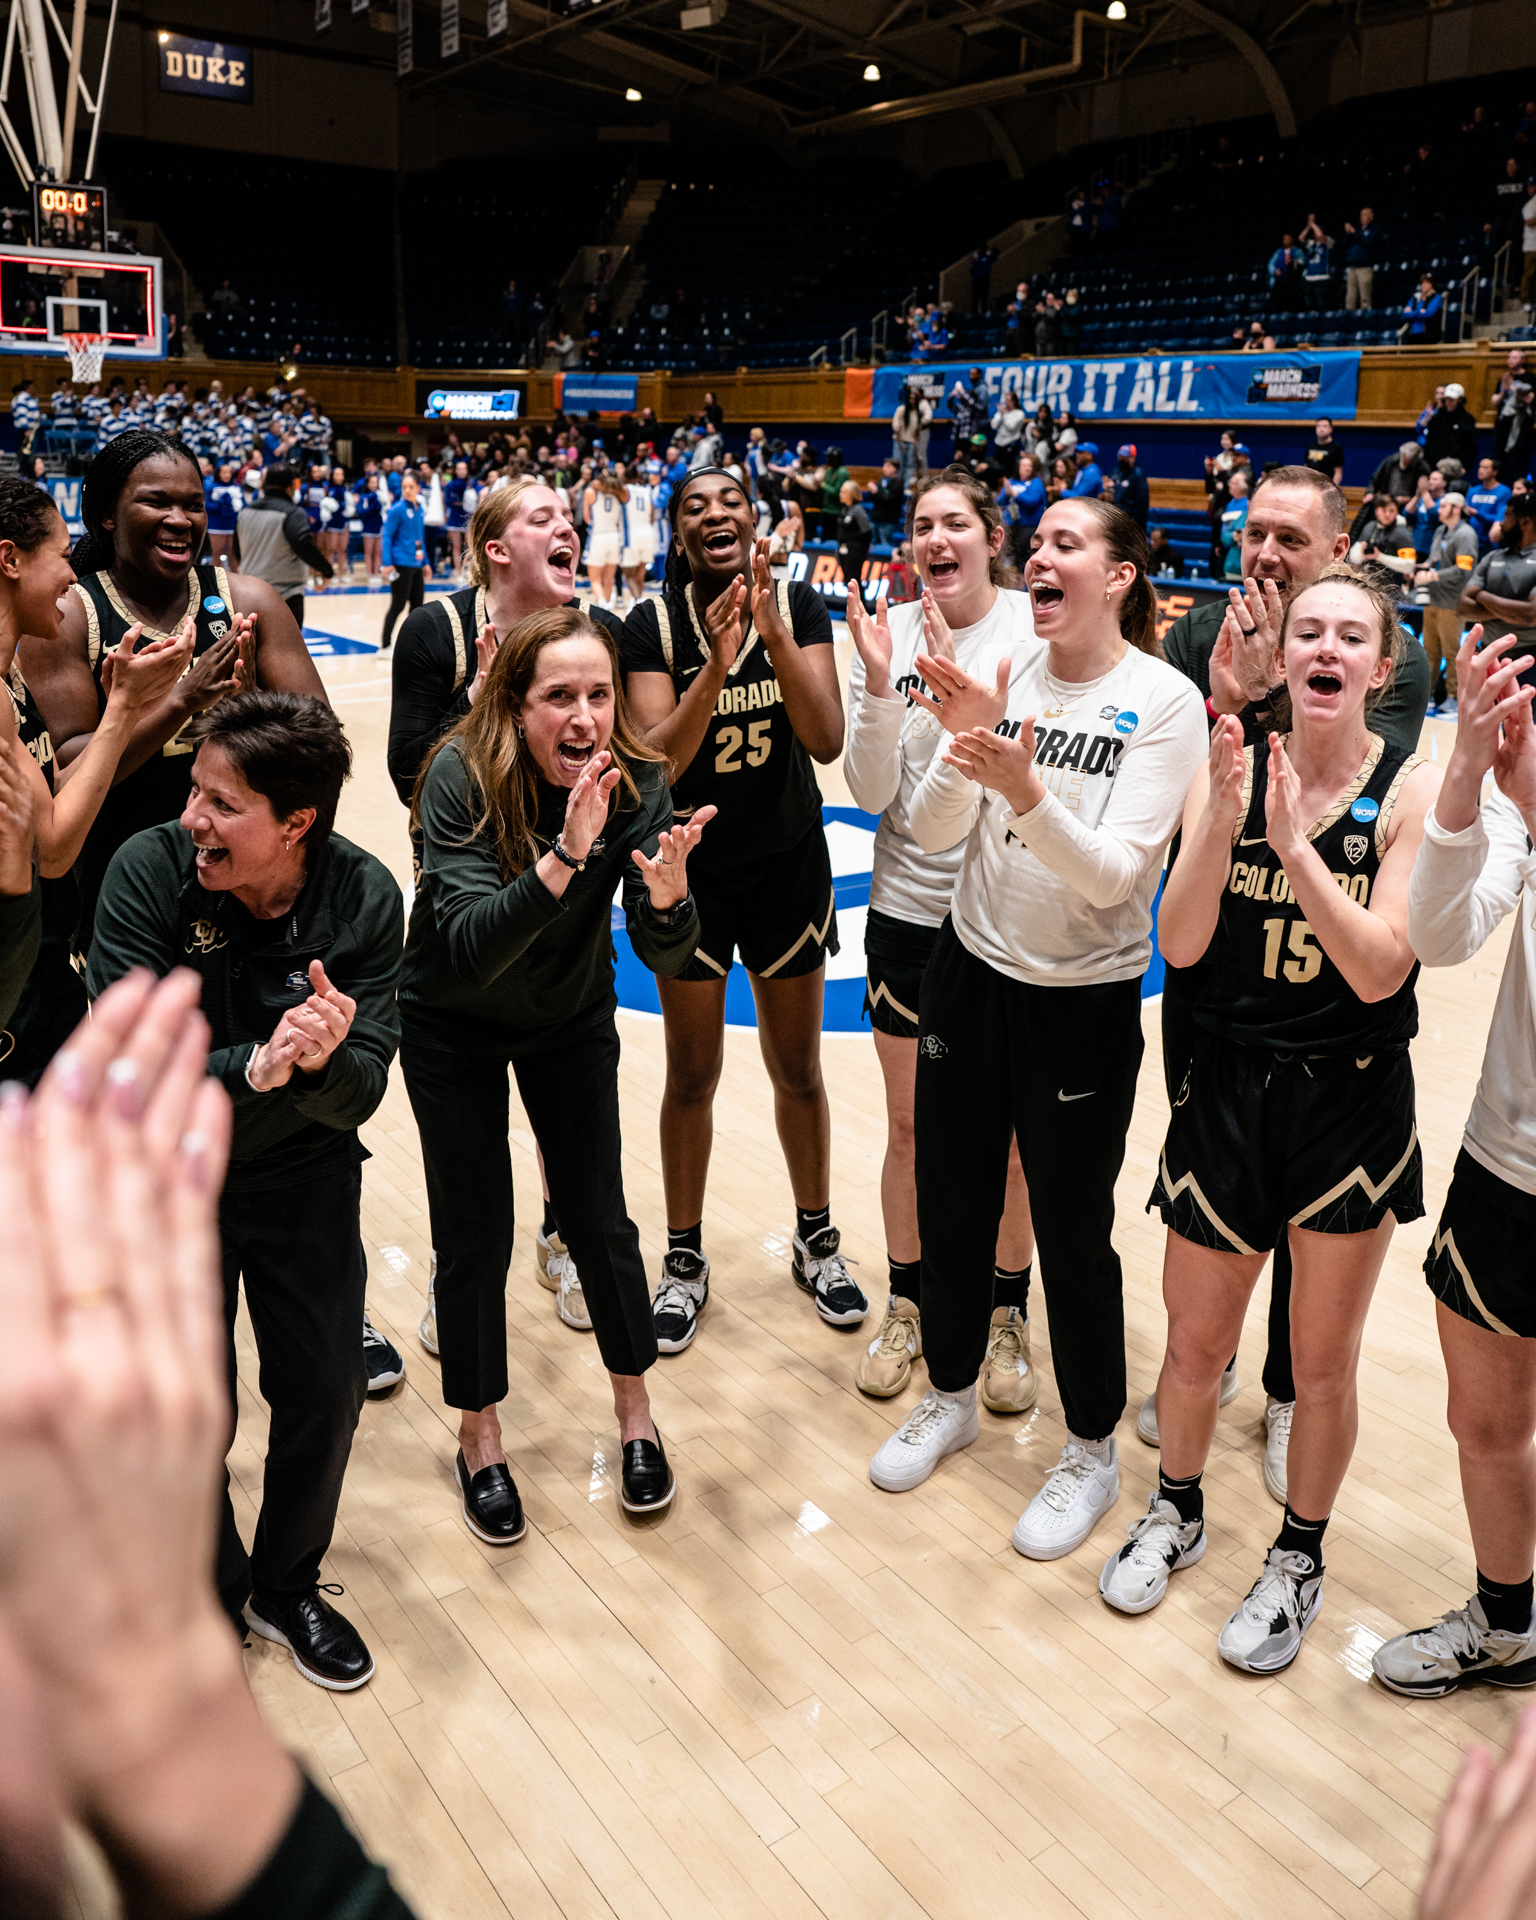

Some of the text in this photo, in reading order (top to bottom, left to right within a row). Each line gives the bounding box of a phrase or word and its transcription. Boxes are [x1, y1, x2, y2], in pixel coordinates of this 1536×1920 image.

[165, 50, 246, 87] DUKE
[41, 188, 88, 214] 00.0
[1078, 361, 1126, 412] IT
[1126, 359, 1200, 412] ALL
[1263, 368, 1303, 383] MARCH
[1266, 382, 1321, 398] MADNESS
[1116, 717, 1136, 731] NCAA
[715, 719, 772, 774] 25
[1354, 807, 1377, 817] NCAA
[1262, 917, 1323, 983] 15
